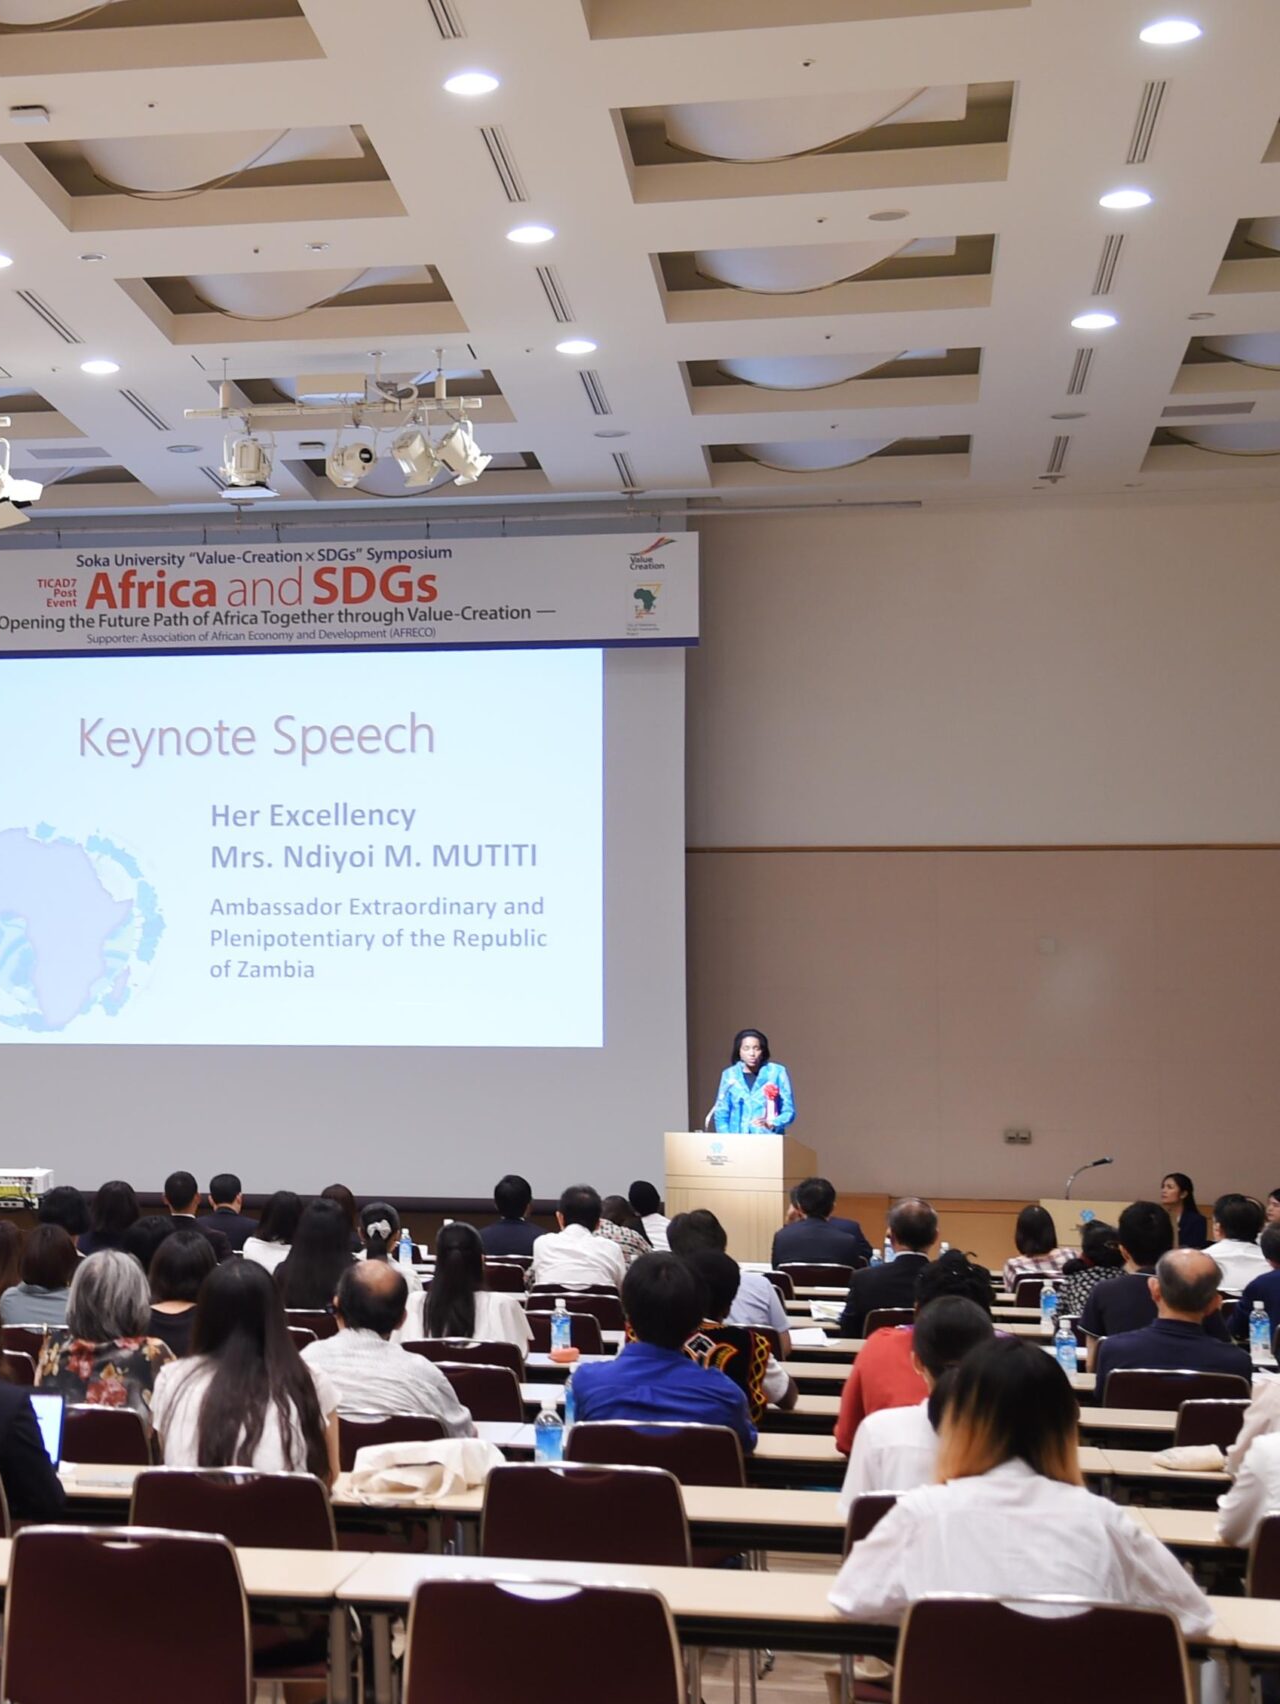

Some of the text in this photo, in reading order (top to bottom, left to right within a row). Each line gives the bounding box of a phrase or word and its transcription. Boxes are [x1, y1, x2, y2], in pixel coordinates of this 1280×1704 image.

[76, 554, 110, 567] Soka
[114, 553, 185, 568] University
[366, 546, 452, 564] Symposium
[37, 578, 77, 588] TICAD7
[54, 589, 77, 597] Post
[85, 565, 438, 609] Africa and SDGs
[46, 599, 77, 608] Event
[69, 614, 95, 628] the
[99, 613, 150, 628] Future
[153, 612, 189, 627] Path
[192, 610, 210, 626] of
[212, 611, 258, 625] Africa
[261, 609, 334, 628] Together
[338, 606, 404, 626] through
[407, 605, 531, 621] Value-Creation
[87, 627, 436, 644] Supporter: Association of African Economy and Development (AFRECO)
[79, 711, 435, 769] Keynote Speech
[211, 802, 417, 832] Her Excellency
[211, 843, 537, 874] Mrs. Ndiyoi M. MUTITI
[210, 896, 545, 919] Ambassador Extraordinary and
[210, 928, 548, 952] Plenipotentiary of the Republic
[210, 959, 315, 978] of Zambia
